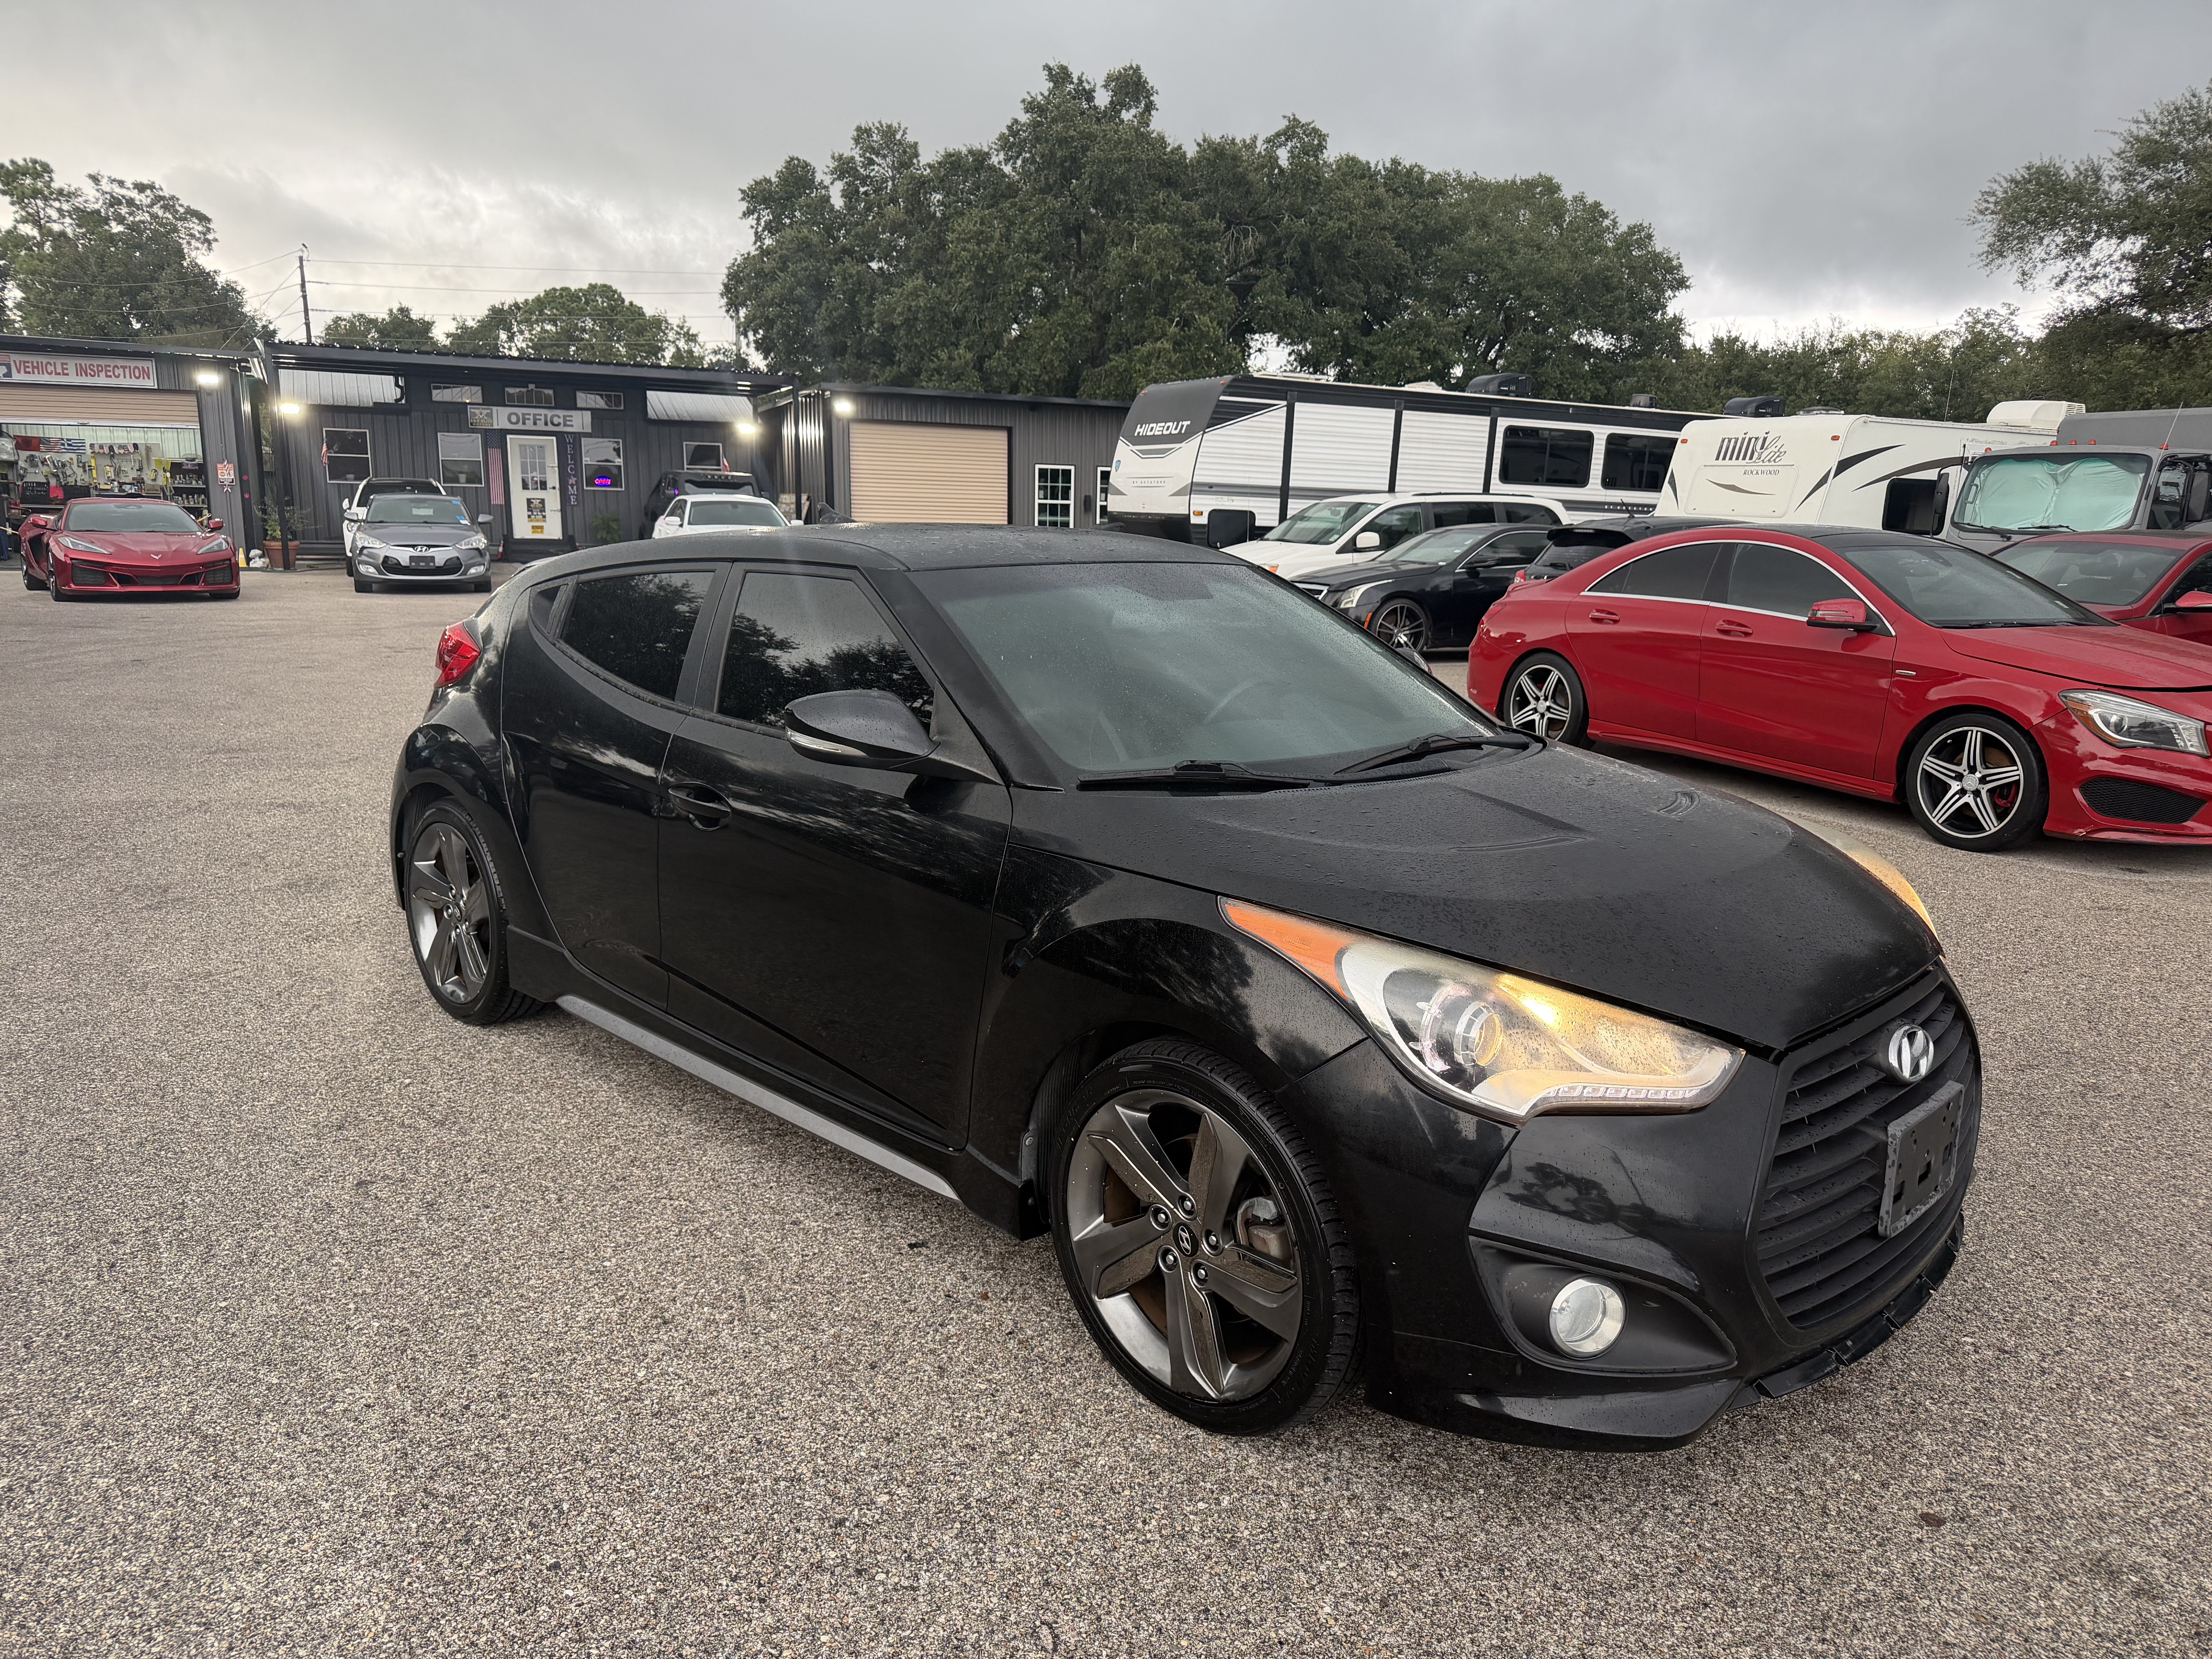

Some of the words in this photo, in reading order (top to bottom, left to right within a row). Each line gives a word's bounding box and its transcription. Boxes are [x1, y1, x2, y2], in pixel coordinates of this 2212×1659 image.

[13, 359, 69, 376] VEHICLE
[75, 362, 151, 380] INSPECTION
[507, 412, 574, 428] OFFICE
[1134, 421, 1191, 436] HIDEOUT
[1715, 431, 1770, 461] mini
[1746, 435, 1787, 464] Lite
